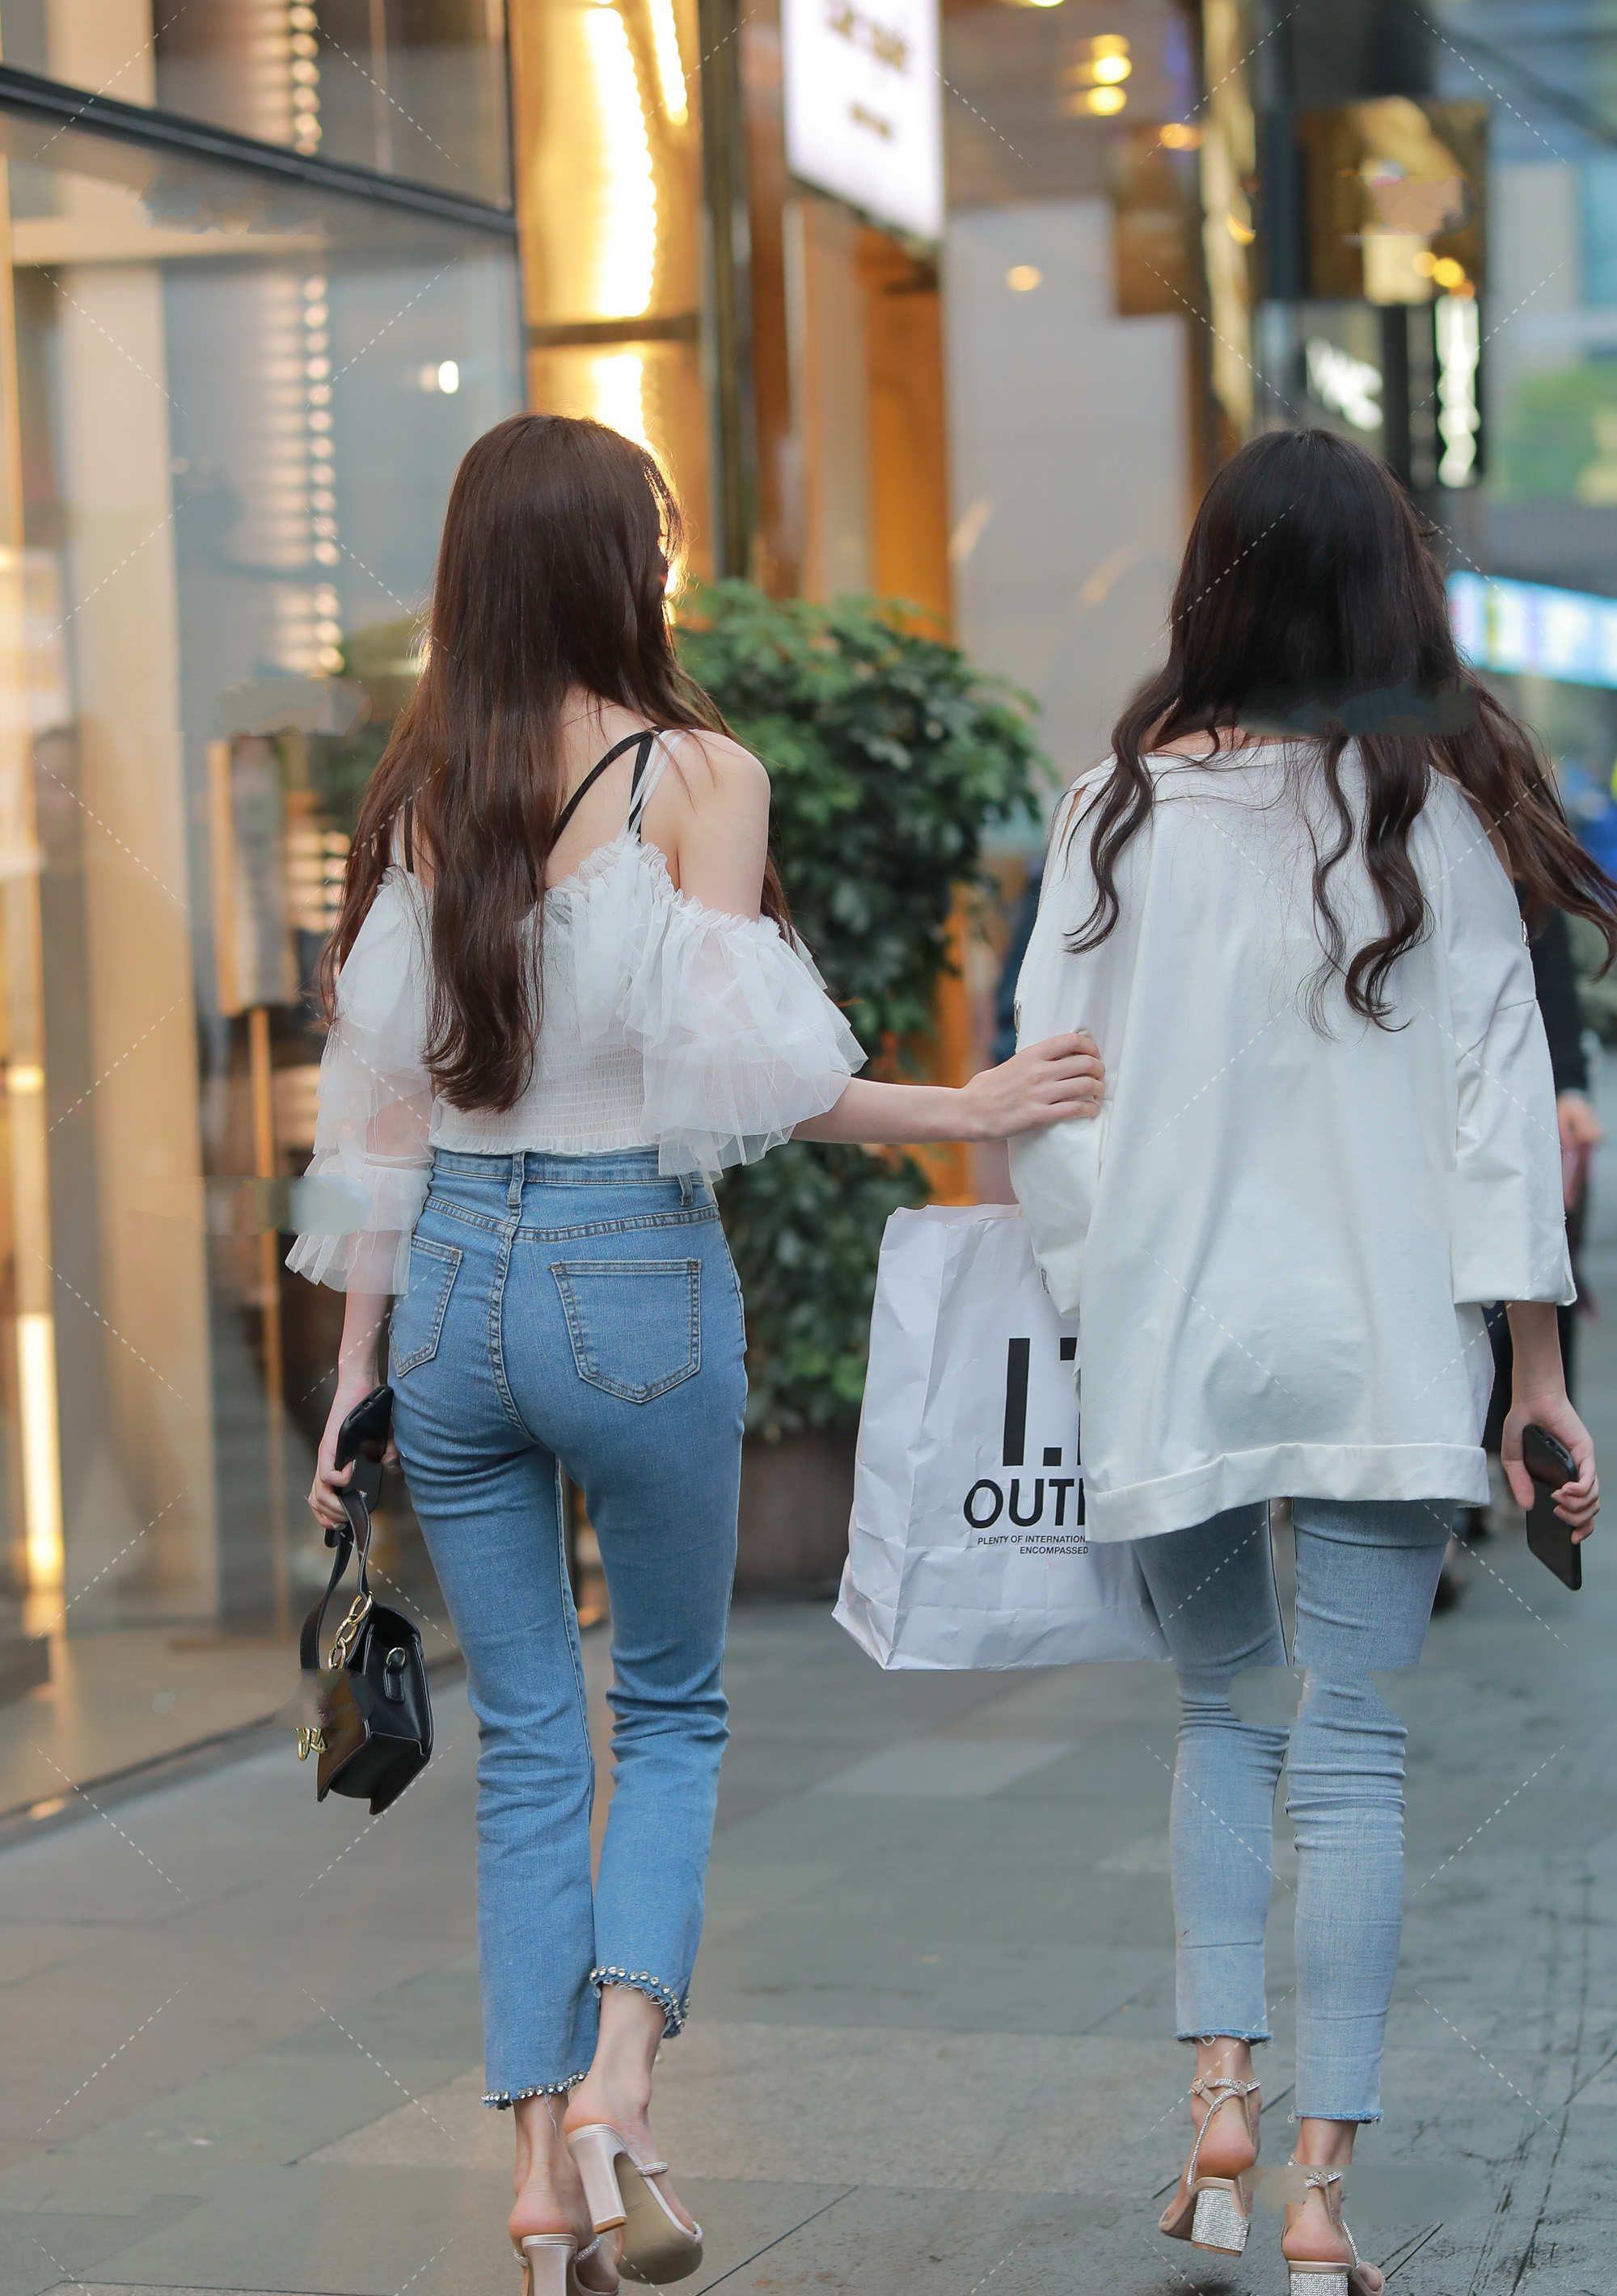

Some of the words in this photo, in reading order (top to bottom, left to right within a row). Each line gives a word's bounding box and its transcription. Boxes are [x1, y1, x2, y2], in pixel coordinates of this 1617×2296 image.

[977, 1535, 1008, 1545] PLENTY
[1011, 1535, 1023, 1543] OF
[1025, 1535, 1086, 1543] INTERNATION
[1020, 1546, 1088, 1555] ENCOMPASSED
